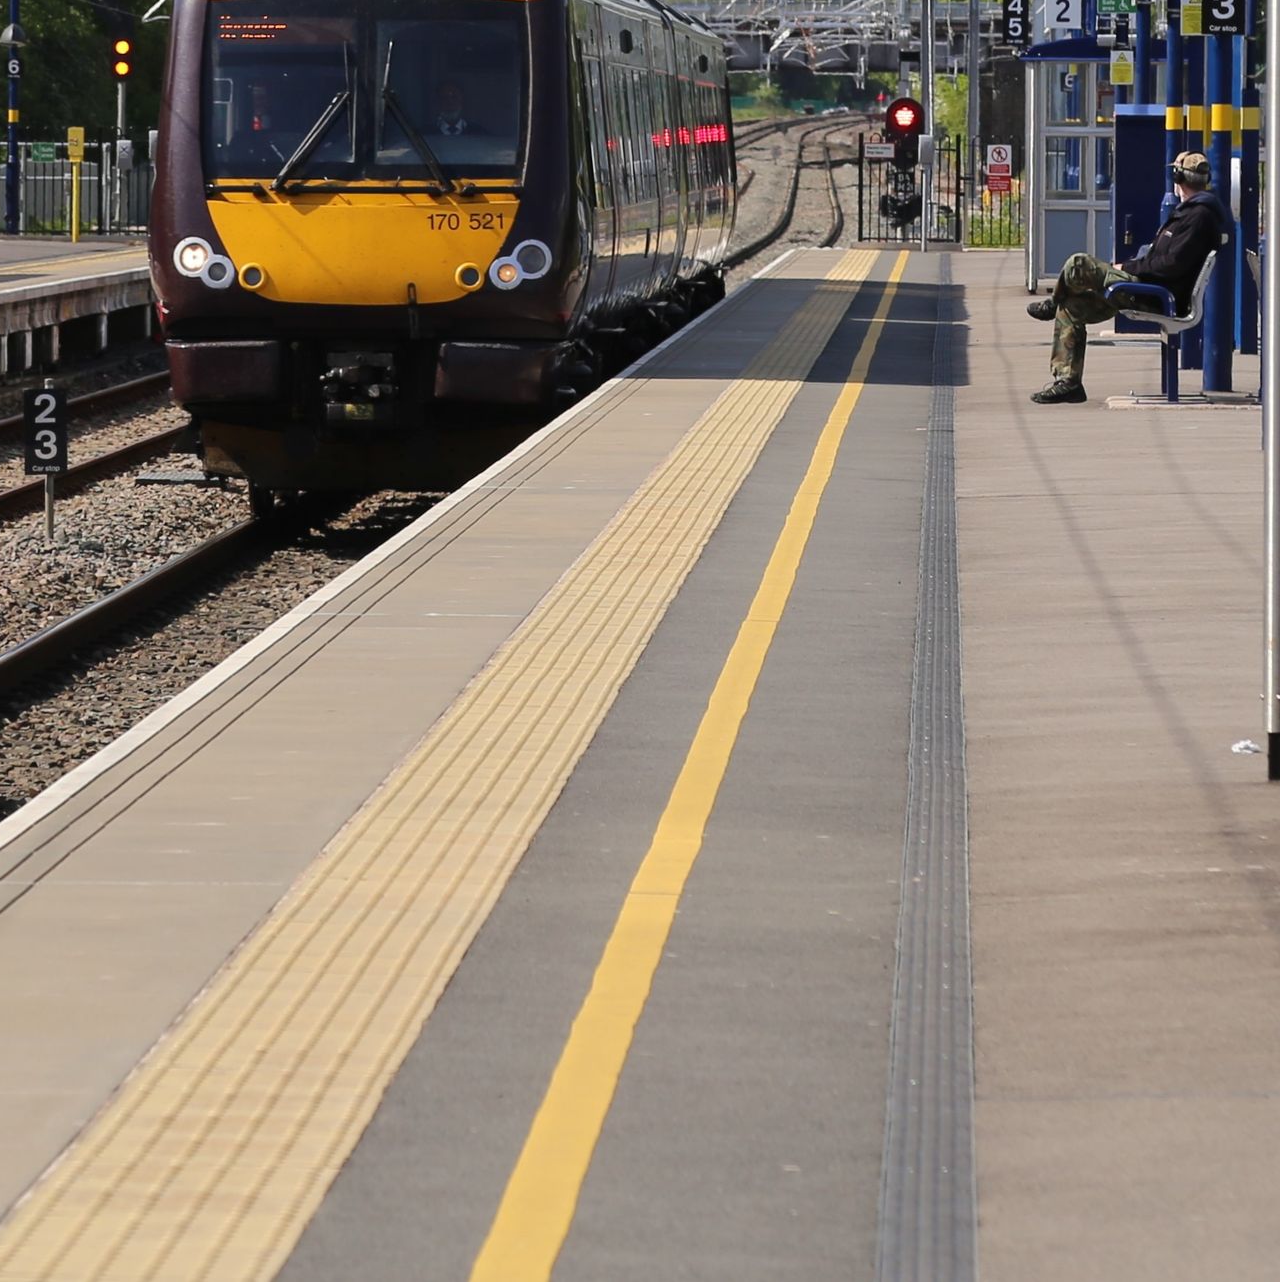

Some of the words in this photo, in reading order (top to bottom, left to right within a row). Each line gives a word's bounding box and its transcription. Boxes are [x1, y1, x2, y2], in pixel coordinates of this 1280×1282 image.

[1008, 17, 1023, 36] 5
[1222, 24, 1237, 32] stop
[8, 59, 20, 74] 6
[427, 213, 460, 230] 170
[469, 213, 504, 230] 521
[34, 393, 57, 424] 2
[34, 429, 58, 460] 3
[45, 465, 61, 473] stop
